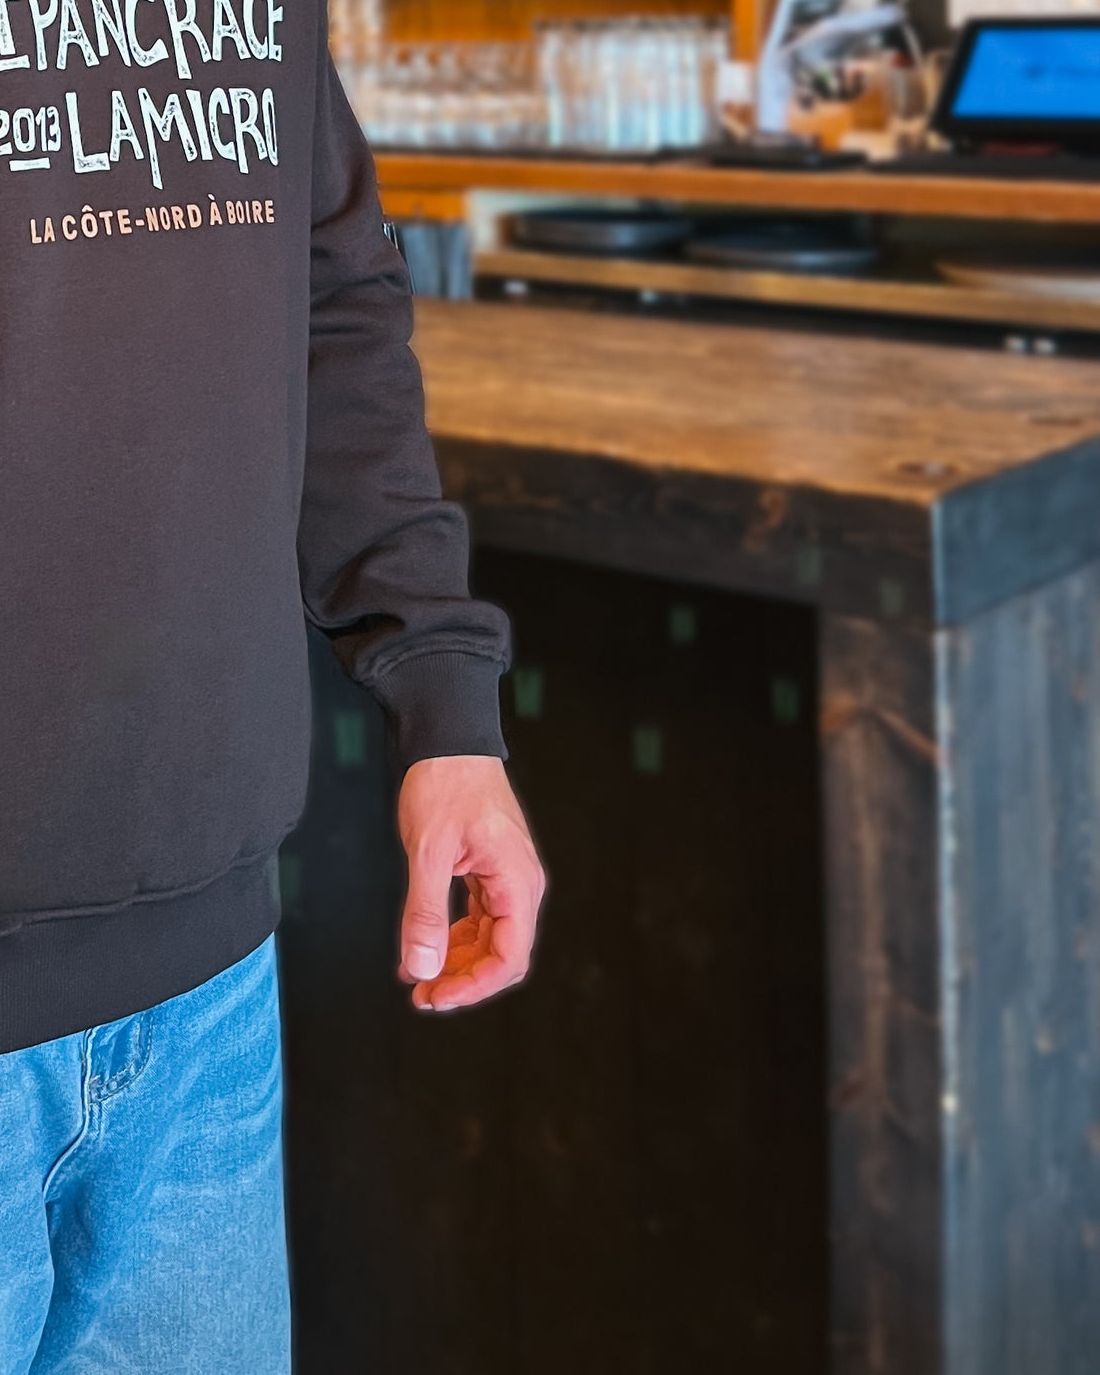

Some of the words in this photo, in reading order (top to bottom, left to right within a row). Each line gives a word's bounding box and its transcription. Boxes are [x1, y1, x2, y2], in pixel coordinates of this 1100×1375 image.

[29, 217, 57, 245] LA
[62, 202, 202, 242] CÔTE-NORD
[208, 192, 224, 226] À
[225, 199, 276, 224] BOIRE
